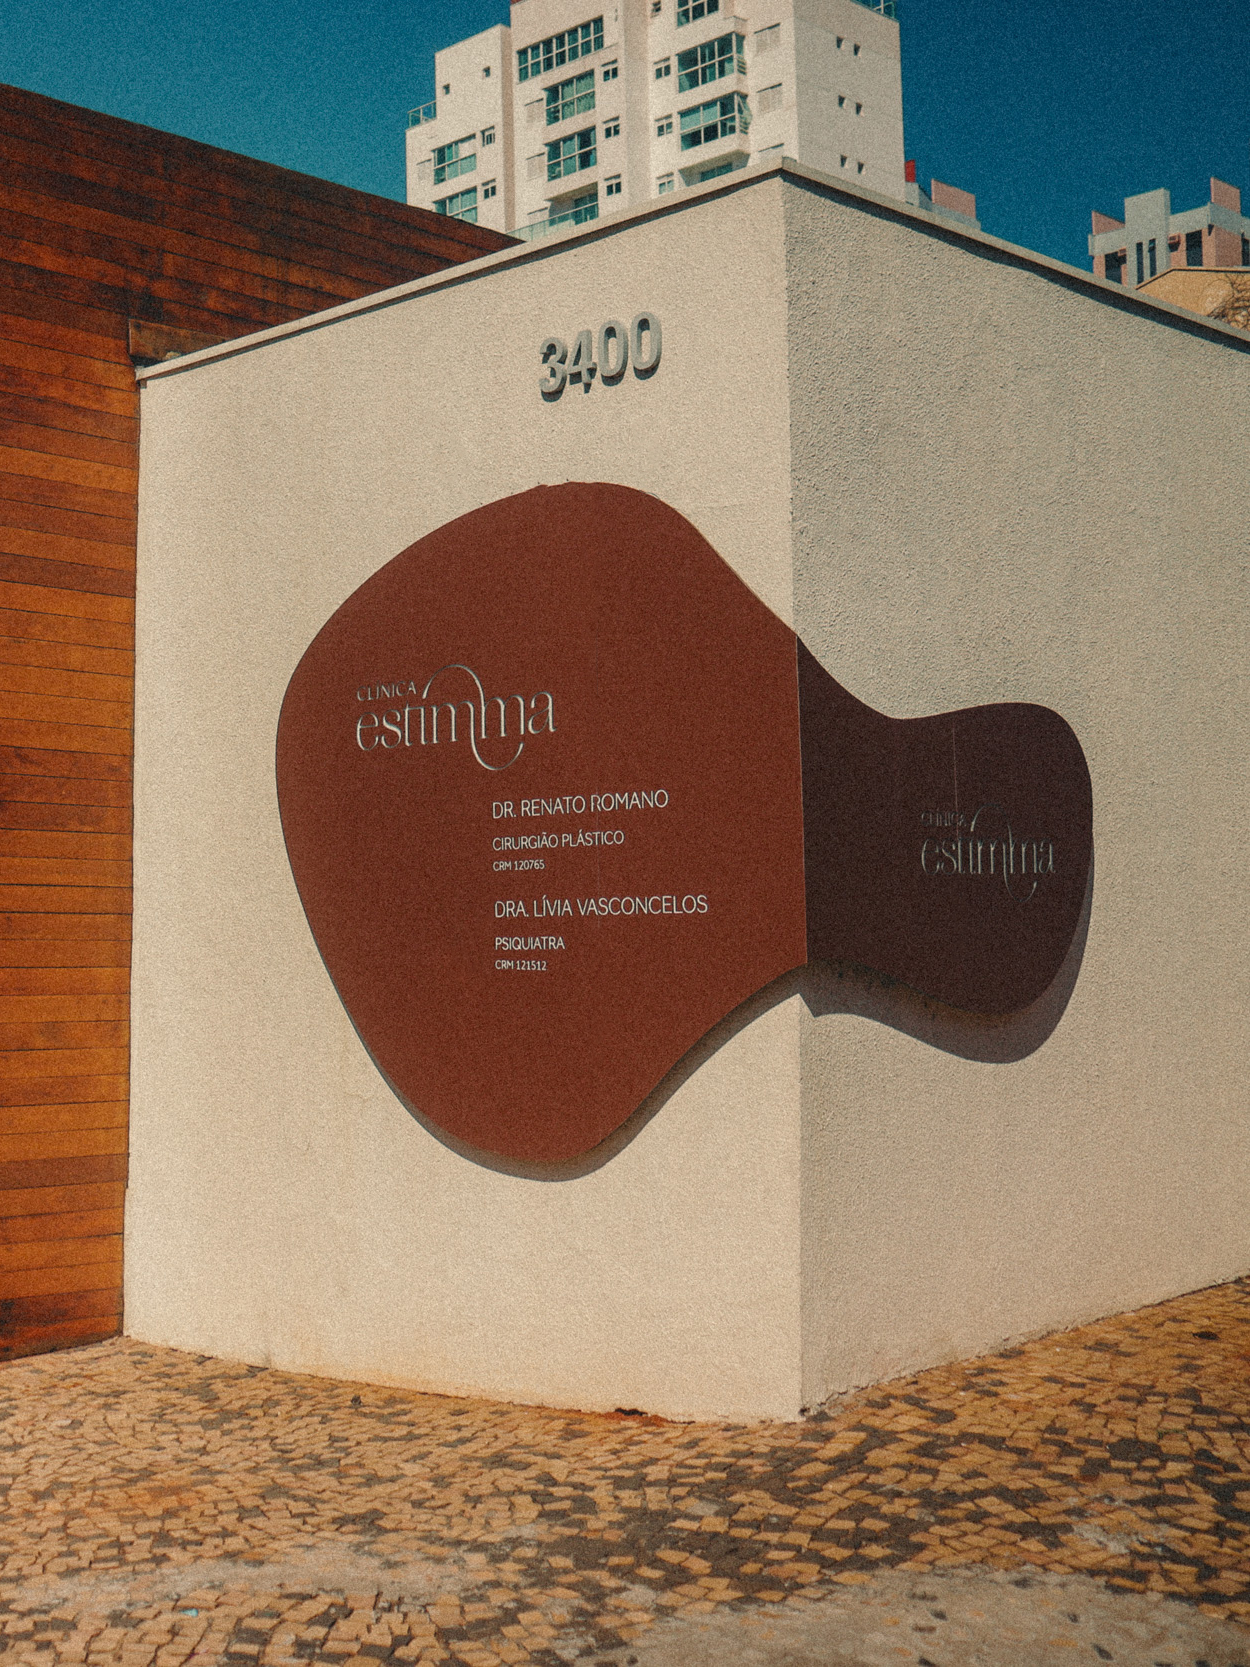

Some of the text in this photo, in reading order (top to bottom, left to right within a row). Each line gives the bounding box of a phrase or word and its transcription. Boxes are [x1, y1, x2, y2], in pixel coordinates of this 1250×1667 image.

[539, 311, 662, 403] 3400
[356, 664, 557, 771] estimma
[492, 789, 669, 819] DR. RENATO ROMANO
[492, 829, 625, 851] CIRURGIÃO PLÁSTICO
[492, 860, 545, 871] CRM 120765
[495, 895, 708, 918] DRA. LÍVIA VASCONCELOS
[495, 937, 565, 950] PSIQUIATRA
[495, 961, 547, 971] CRM 121512
